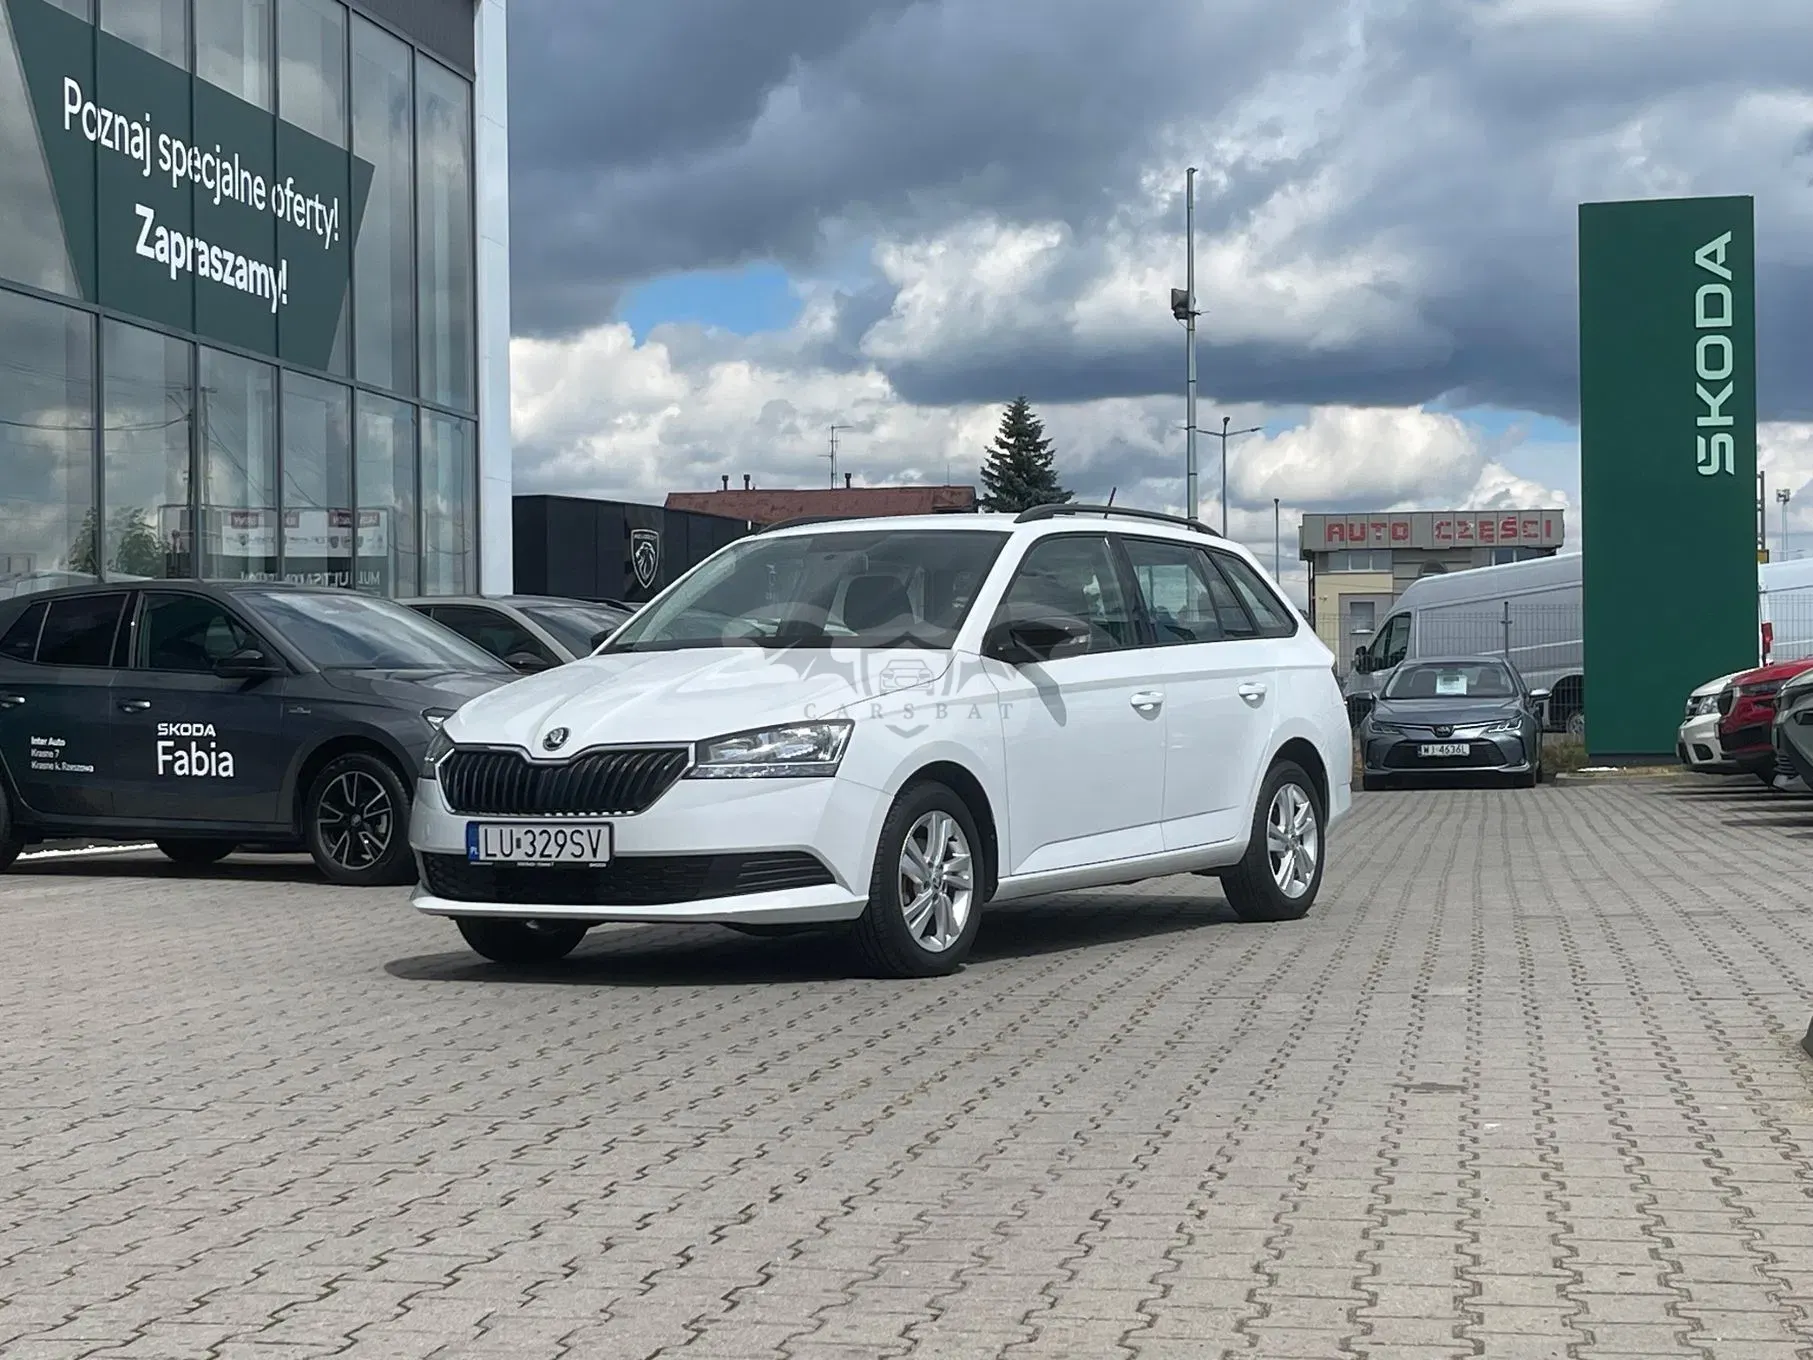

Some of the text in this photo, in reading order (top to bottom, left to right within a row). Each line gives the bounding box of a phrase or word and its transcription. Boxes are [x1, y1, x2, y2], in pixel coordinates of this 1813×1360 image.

[64, 76, 339, 250] Poznaj specjalne oferty!
[135, 203, 288, 314] Zapraszamy!
[1327, 516, 1552, 543] AUTO CZĘŚCI
[157, 740, 234, 777] Fabia
[484, 829, 602, 859] LU 329SV
